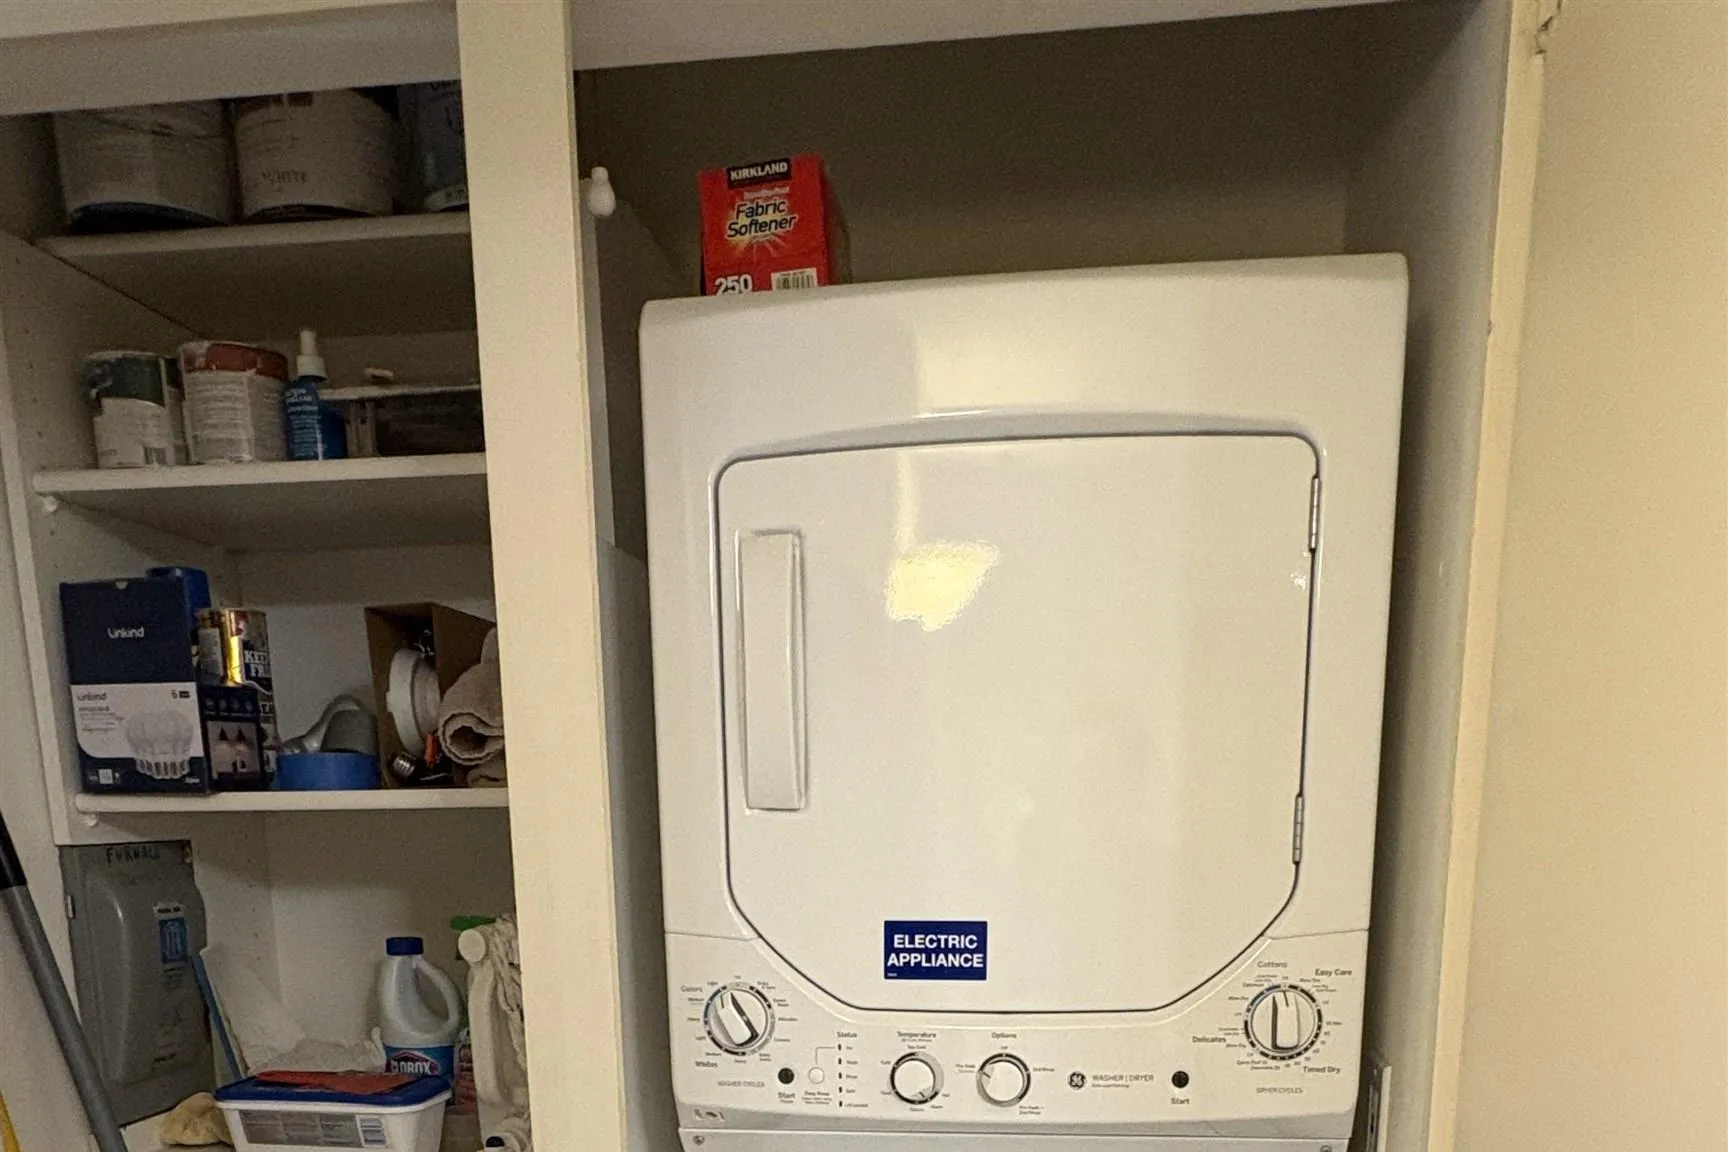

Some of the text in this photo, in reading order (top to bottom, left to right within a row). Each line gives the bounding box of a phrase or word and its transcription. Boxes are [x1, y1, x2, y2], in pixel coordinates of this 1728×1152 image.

[730, 162, 788, 181] KIRKLAND
[735, 200, 786, 220] Fabric
[726, 215, 797, 238] Softener
[714, 273, 753, 296] 250
[893, 934, 978, 949] ELECTRIC
[887, 952, 984, 968] APPLIANCE
[1257, 960, 1288, 968] Cottons
[1315, 968, 1353, 977] Easy Care
[897, 1031, 937, 1039] Temperature
[1327, 1066, 1342, 1074] Dry
